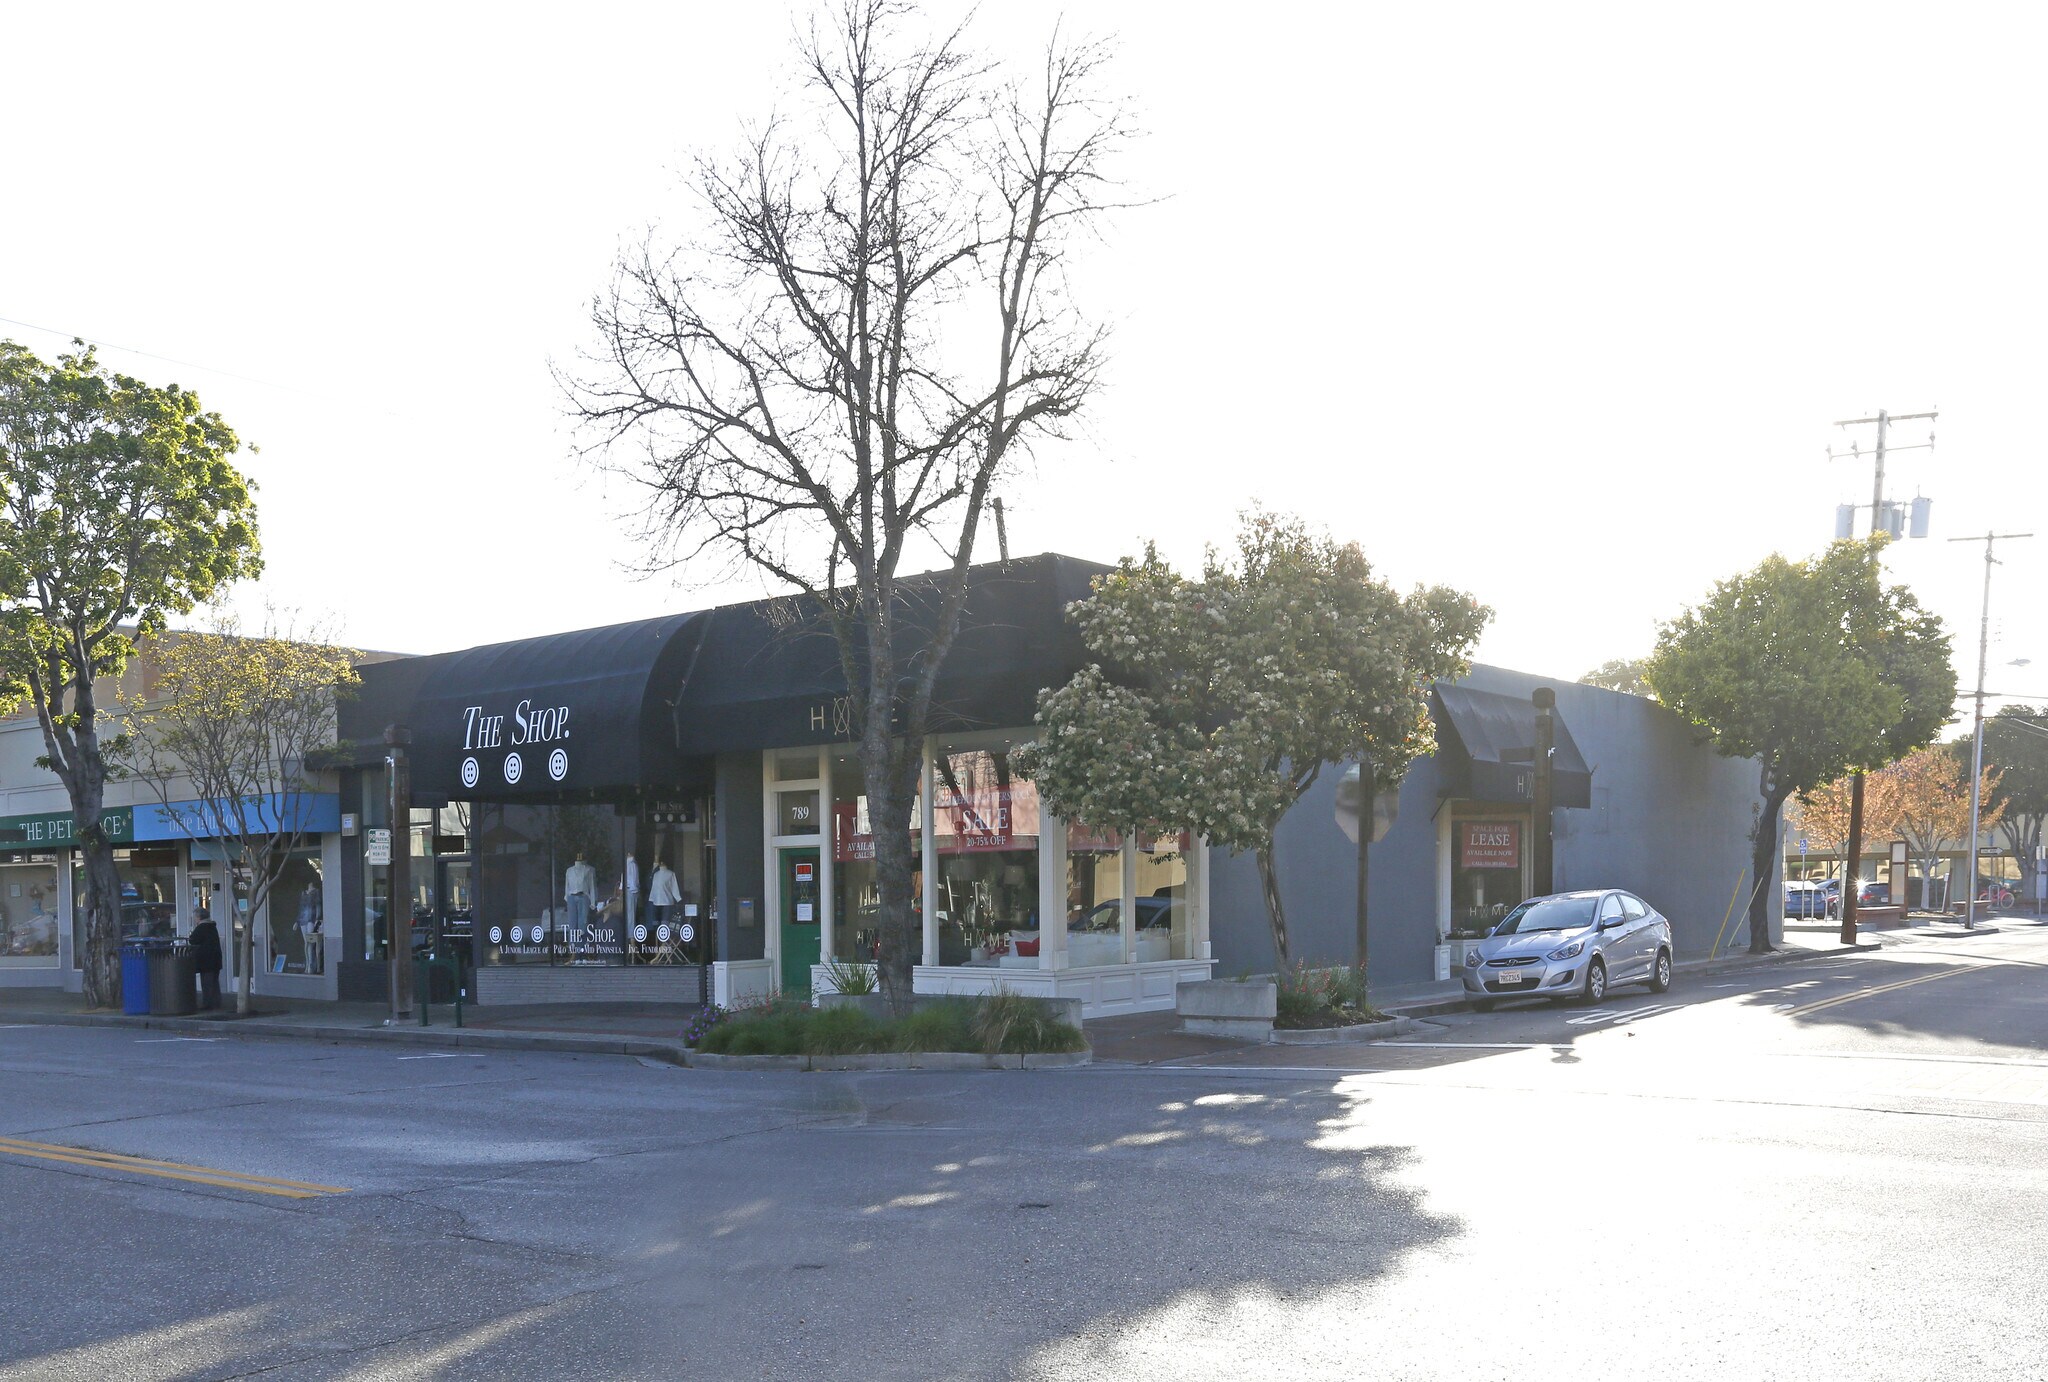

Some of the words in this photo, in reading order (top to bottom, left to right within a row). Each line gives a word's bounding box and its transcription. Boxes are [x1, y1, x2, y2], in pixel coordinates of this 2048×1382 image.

[463, 706, 504, 750] THE
[511, 699, 570, 745] SHOP.
[196, 806, 238, 831] illuion
[792, 806, 810, 820] 789
[962, 807, 1009, 833] SALE
[48, 819, 73, 839] PET
[847, 842, 875, 852] AVAILA
[990, 835, 1007, 846] OFF
[1470, 833, 1510, 846] LEASE
[561, 924, 583, 942] THE
[586, 923, 616, 943] SHOP.
